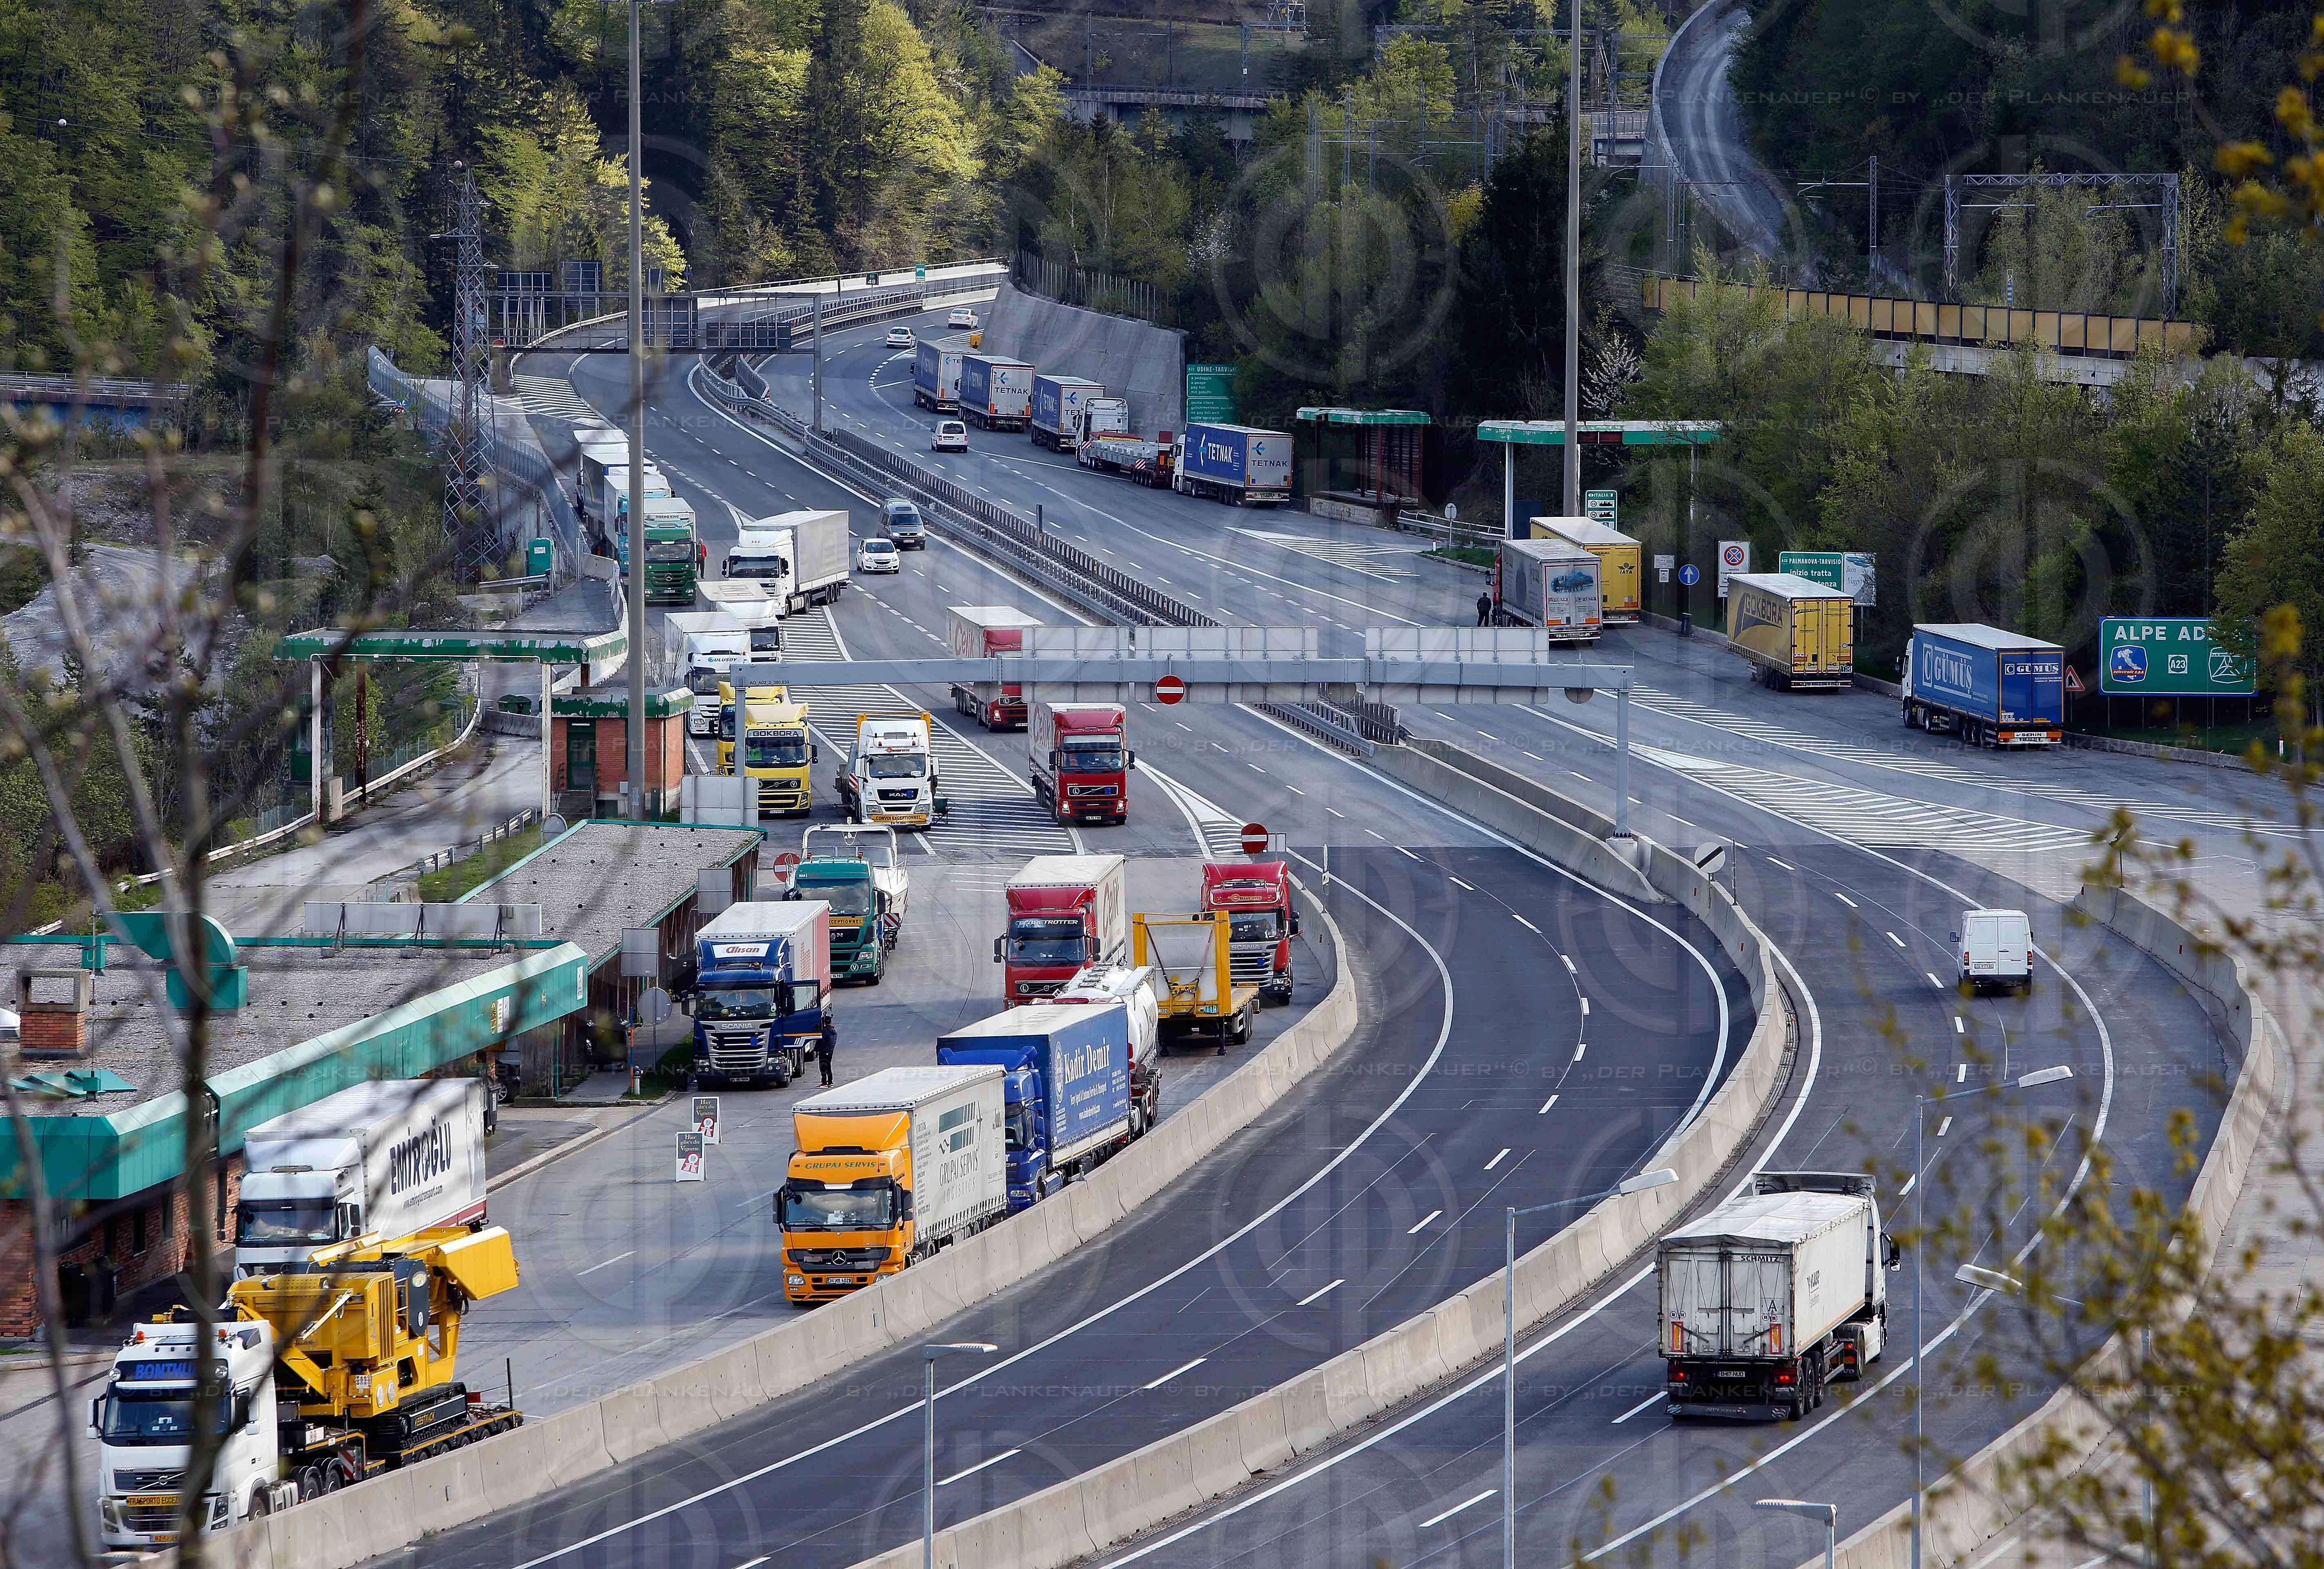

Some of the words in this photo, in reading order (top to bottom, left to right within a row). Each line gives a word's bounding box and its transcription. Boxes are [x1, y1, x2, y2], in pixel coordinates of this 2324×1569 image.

[1208, 442, 1233, 463] TETNAK
[1745, 593, 1783, 628] GOKBORA
[2114, 626, 2166, 641] ALPE
[1934, 652, 1973, 694] GÜMÜŞ
[2016, 663, 2059, 674] GÜMÜŞ
[2170, 659, 2186, 668] A23
[1103, 876, 1120, 939] Celik
[1064, 1047, 1085, 1085] Kadir
[1086, 1037, 1110, 1075] Demir
[389, 1114, 451, 1195] EMİROĞLU
[943, 1176, 975, 1204] LOGISTICS
[1768, 1299, 1778, 1312] A
[135, 1362, 199, 1380] BONTHU
[129, 1497, 161, 1505] TRASPORTO
